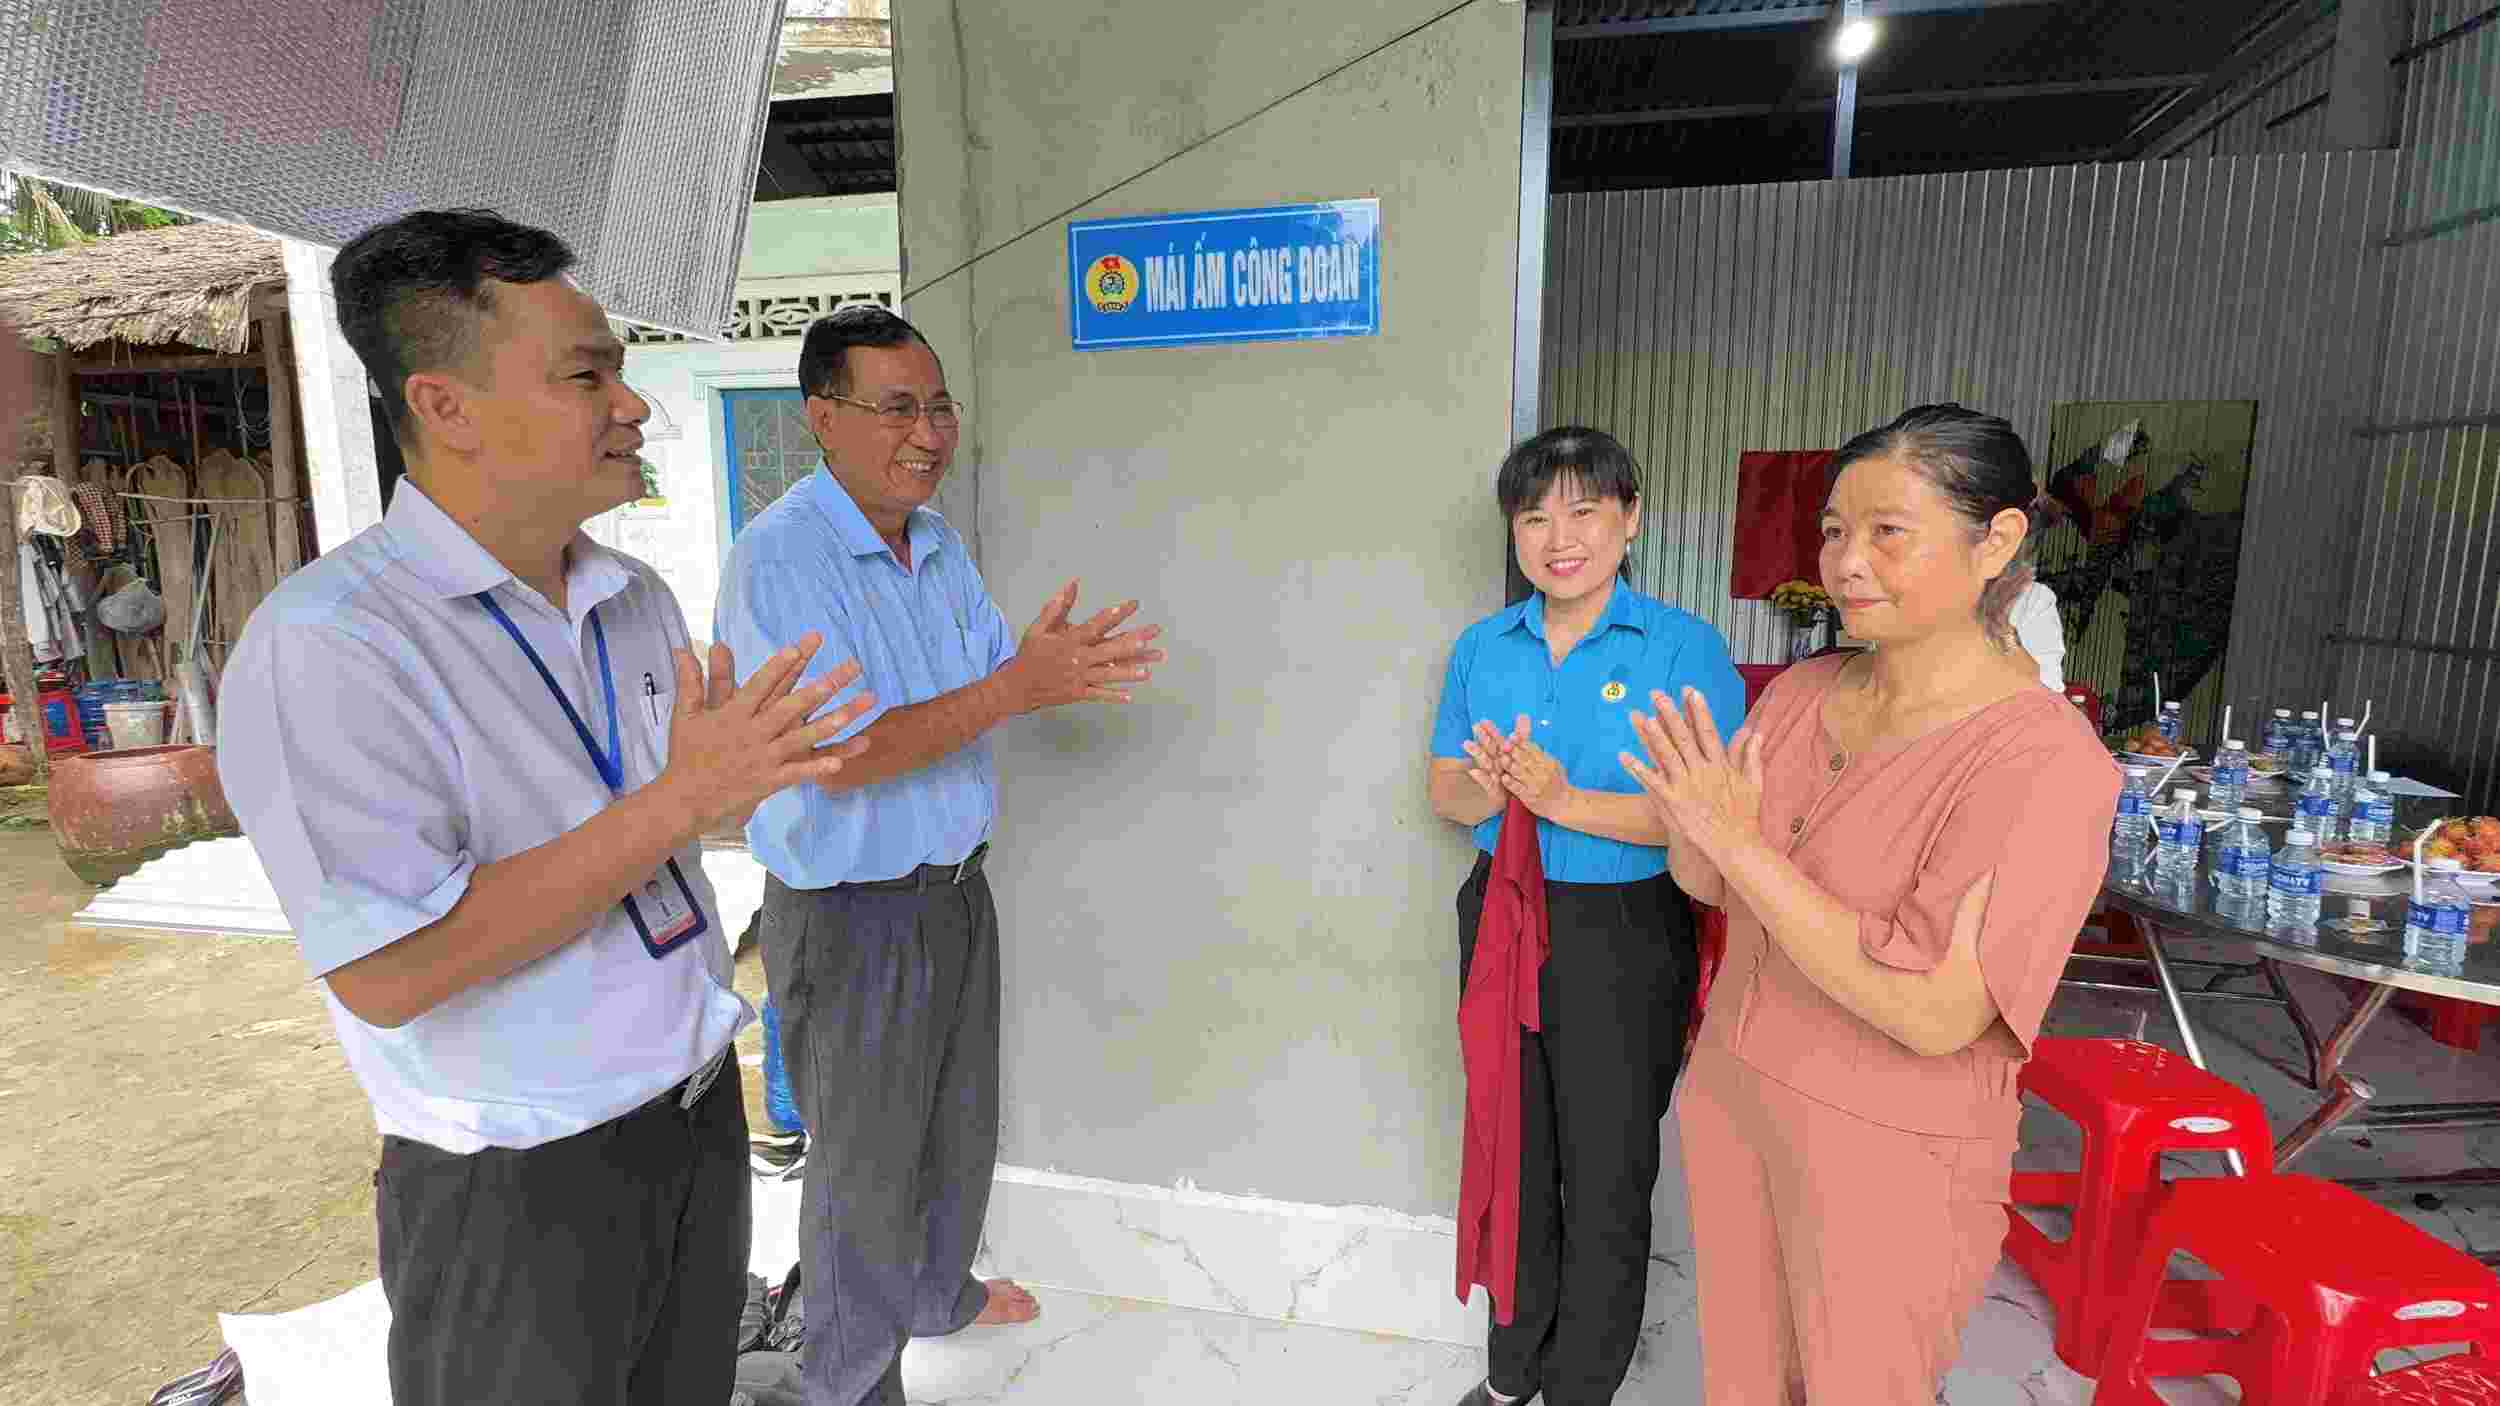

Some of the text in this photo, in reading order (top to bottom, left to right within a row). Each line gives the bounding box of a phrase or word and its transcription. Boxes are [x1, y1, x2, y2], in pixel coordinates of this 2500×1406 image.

[1144, 241, 1185, 312] MÁI
[1192, 231, 1226, 309] ẤM
[1232, 236, 1293, 307] CÔNG
